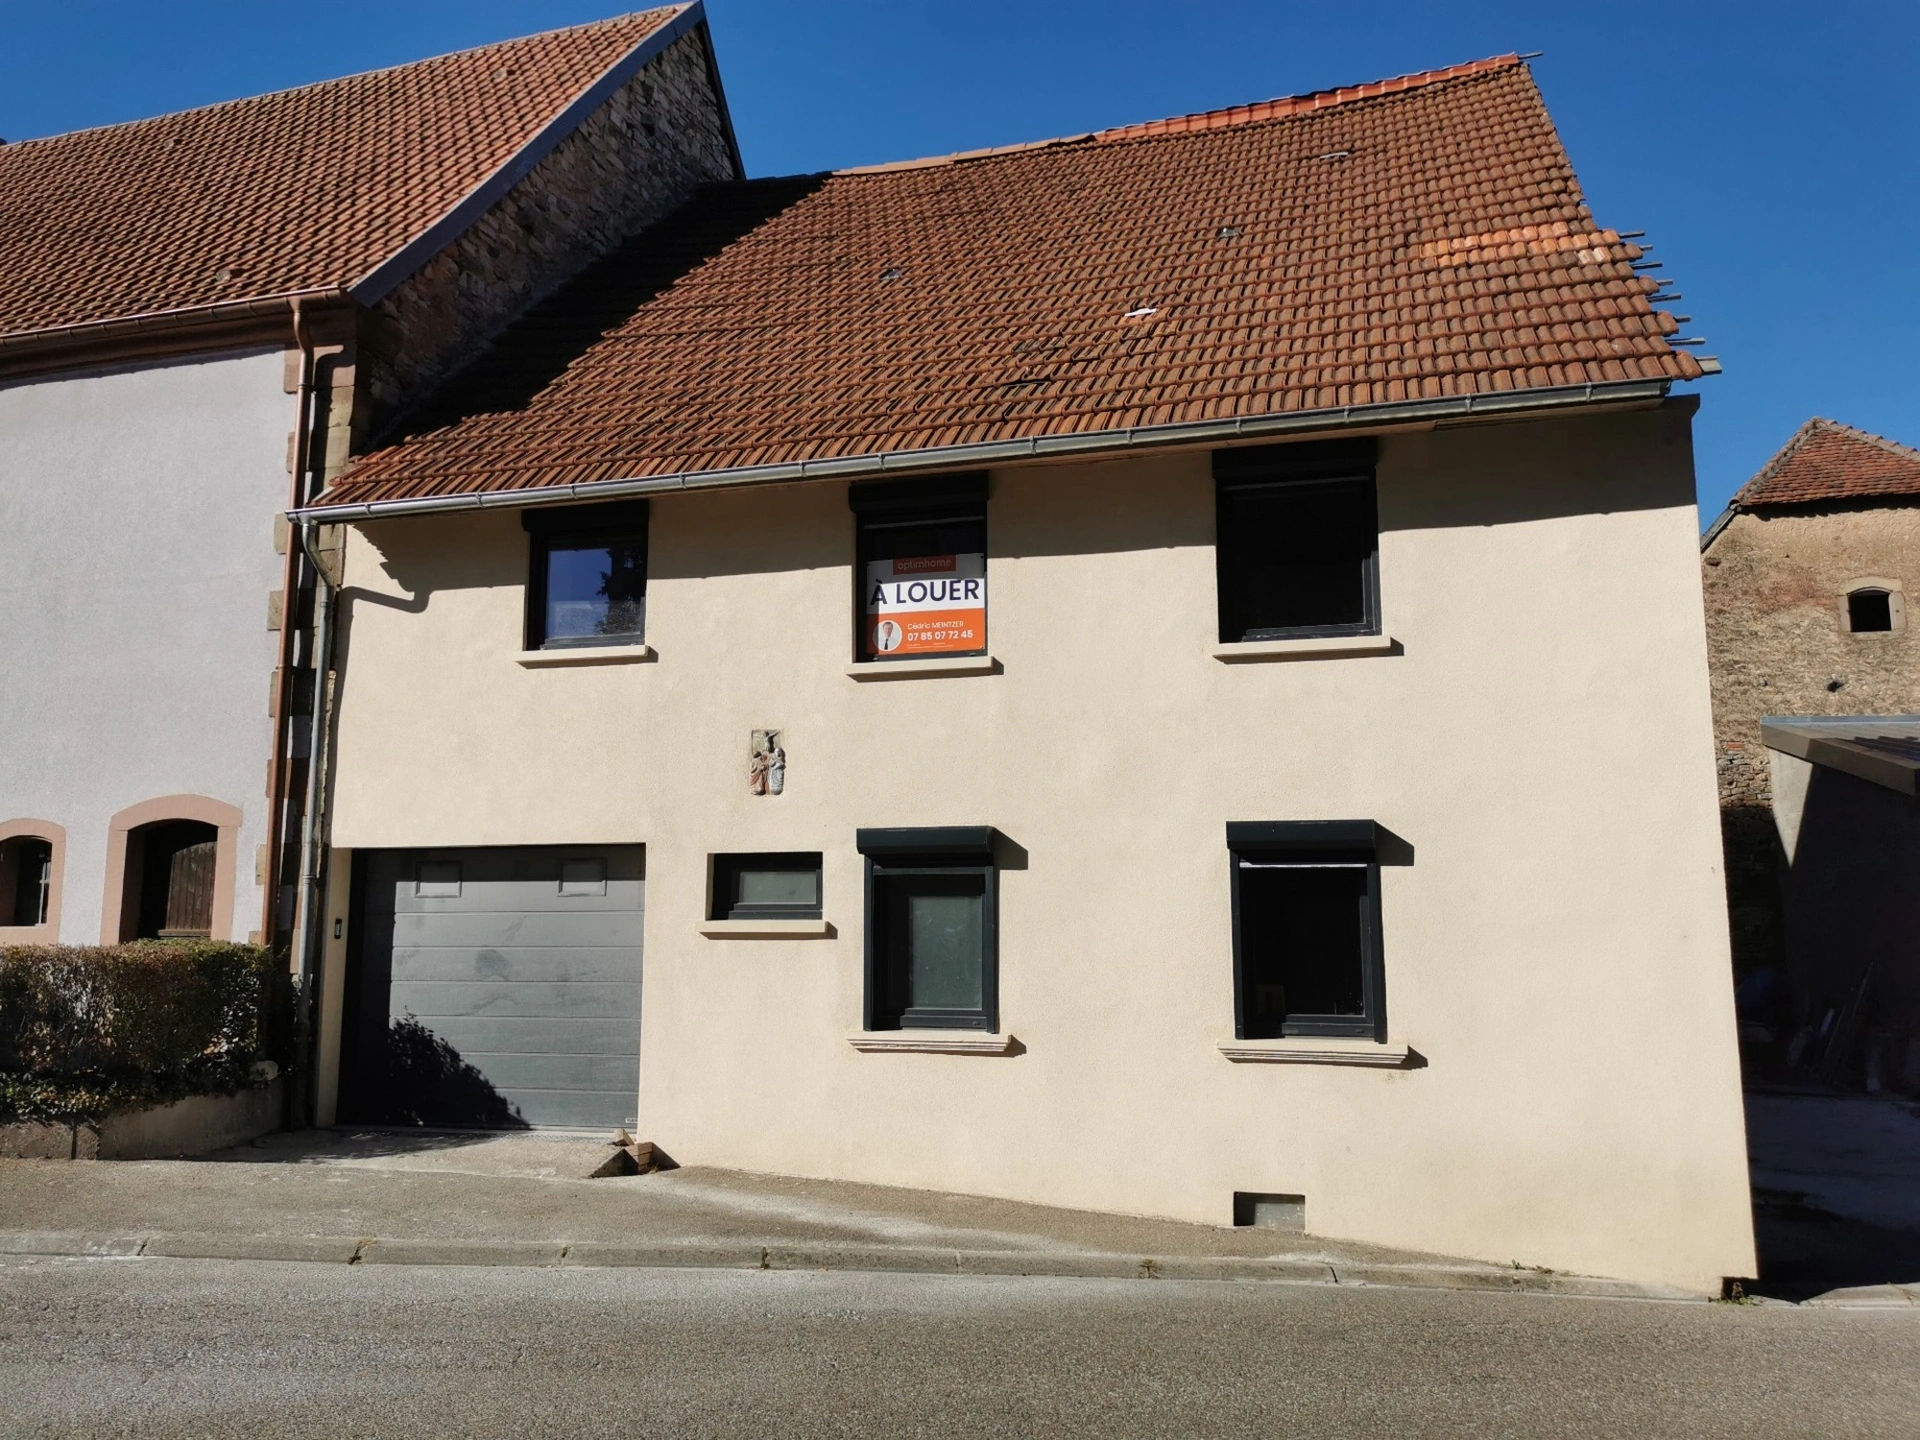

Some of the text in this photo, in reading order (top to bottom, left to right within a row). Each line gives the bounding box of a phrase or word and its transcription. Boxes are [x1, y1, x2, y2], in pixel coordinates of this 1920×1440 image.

[897, 558, 951, 570] optimhome
[870, 578, 979, 605] À LOUER
[907, 620, 964, 630] Cédric MEINTZER
[907, 629, 973, 641] 07 85 07 72 45
